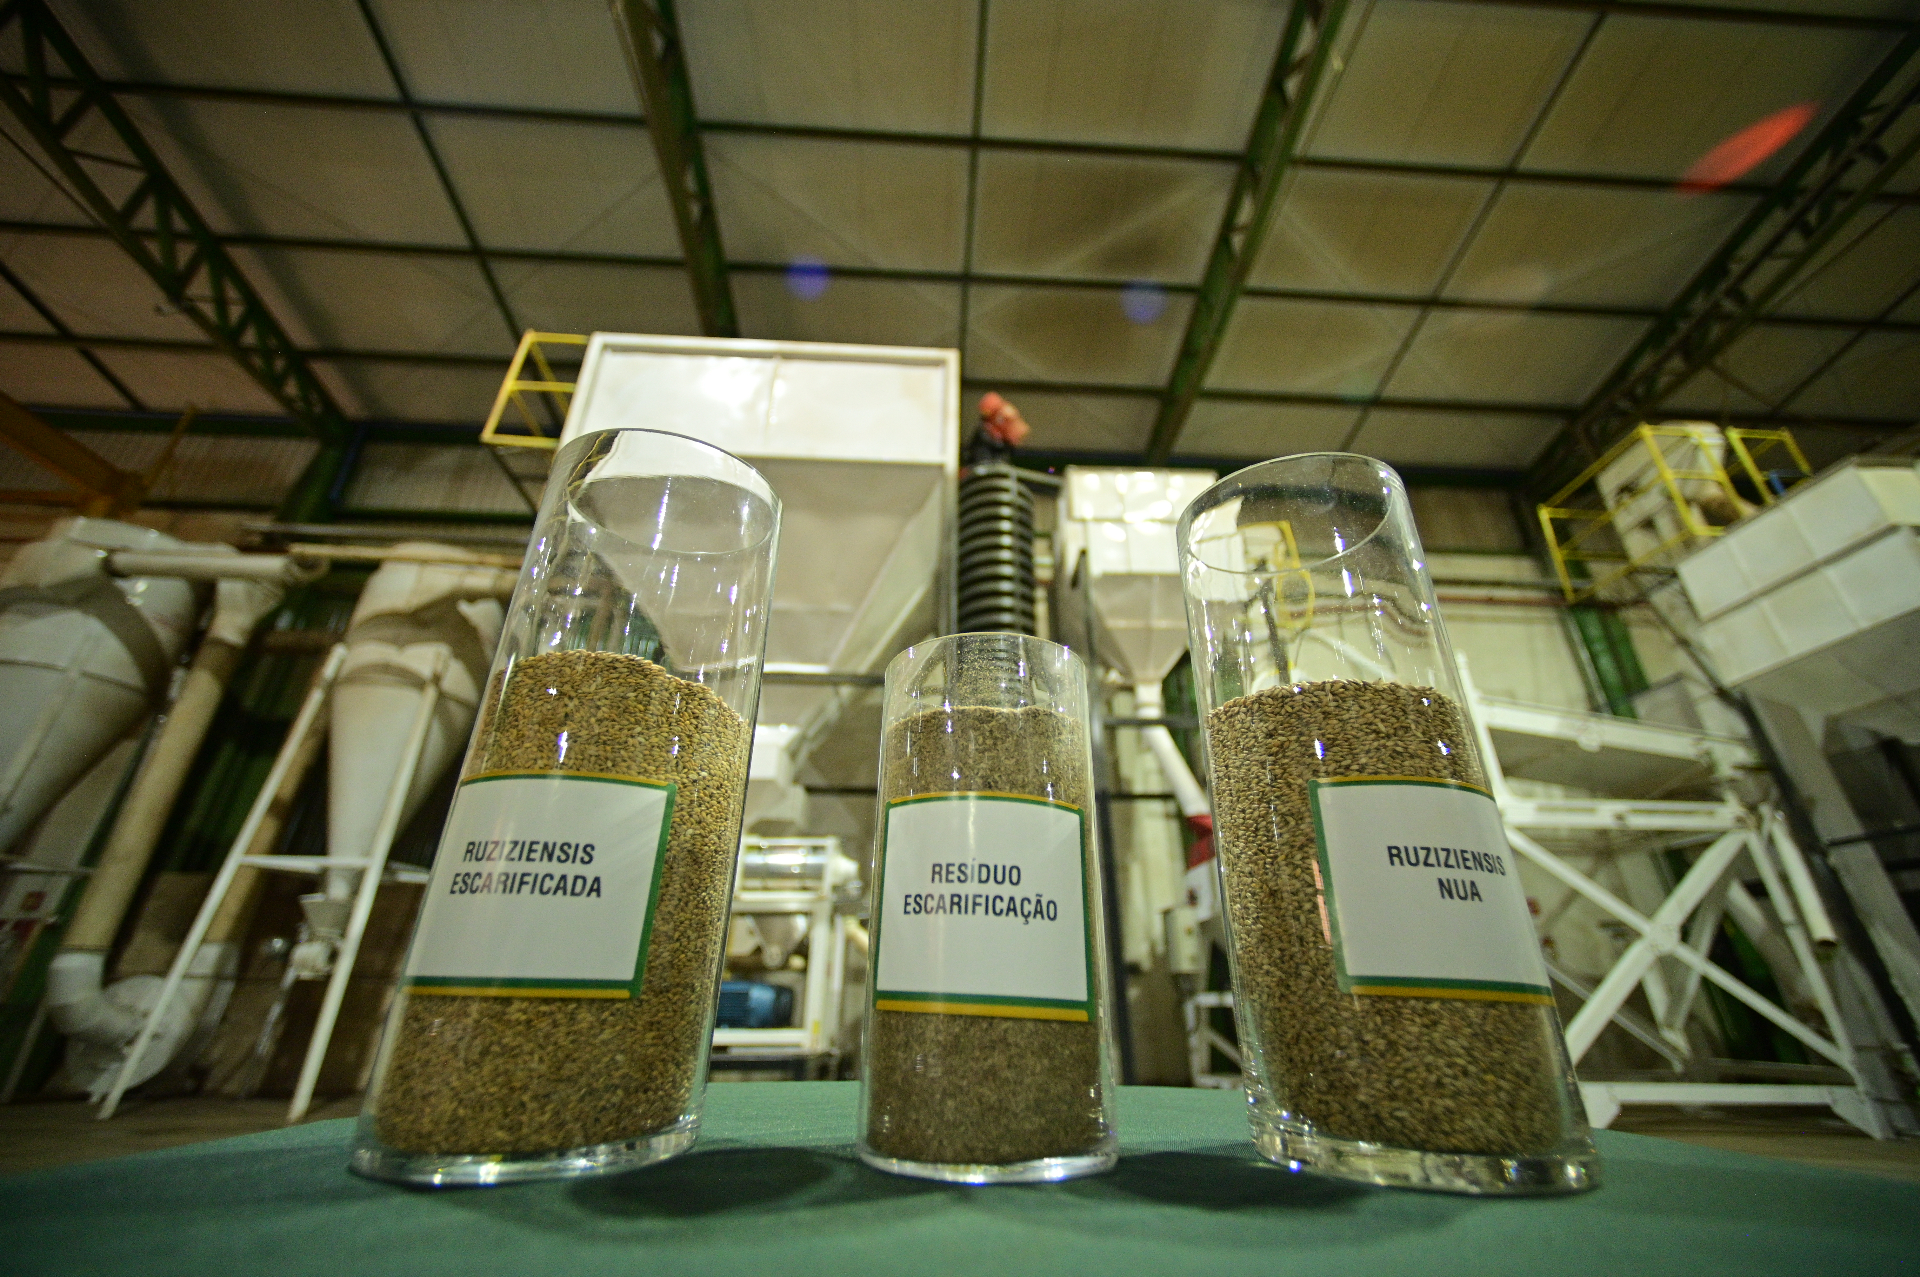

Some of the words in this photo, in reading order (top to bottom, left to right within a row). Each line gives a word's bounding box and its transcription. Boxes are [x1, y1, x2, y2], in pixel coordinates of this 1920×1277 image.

[463, 840, 595, 865] RUZIZIENSIS
[1387, 845, 1506, 876] RUZIZIENSIS
[450, 872, 602, 898] ESCARIFICADA
[931, 858, 1021, 886] RESÍDUO
[1437, 877, 1483, 902] NUA
[903, 893, 1058, 925] ESCARIFICAÇÃO
